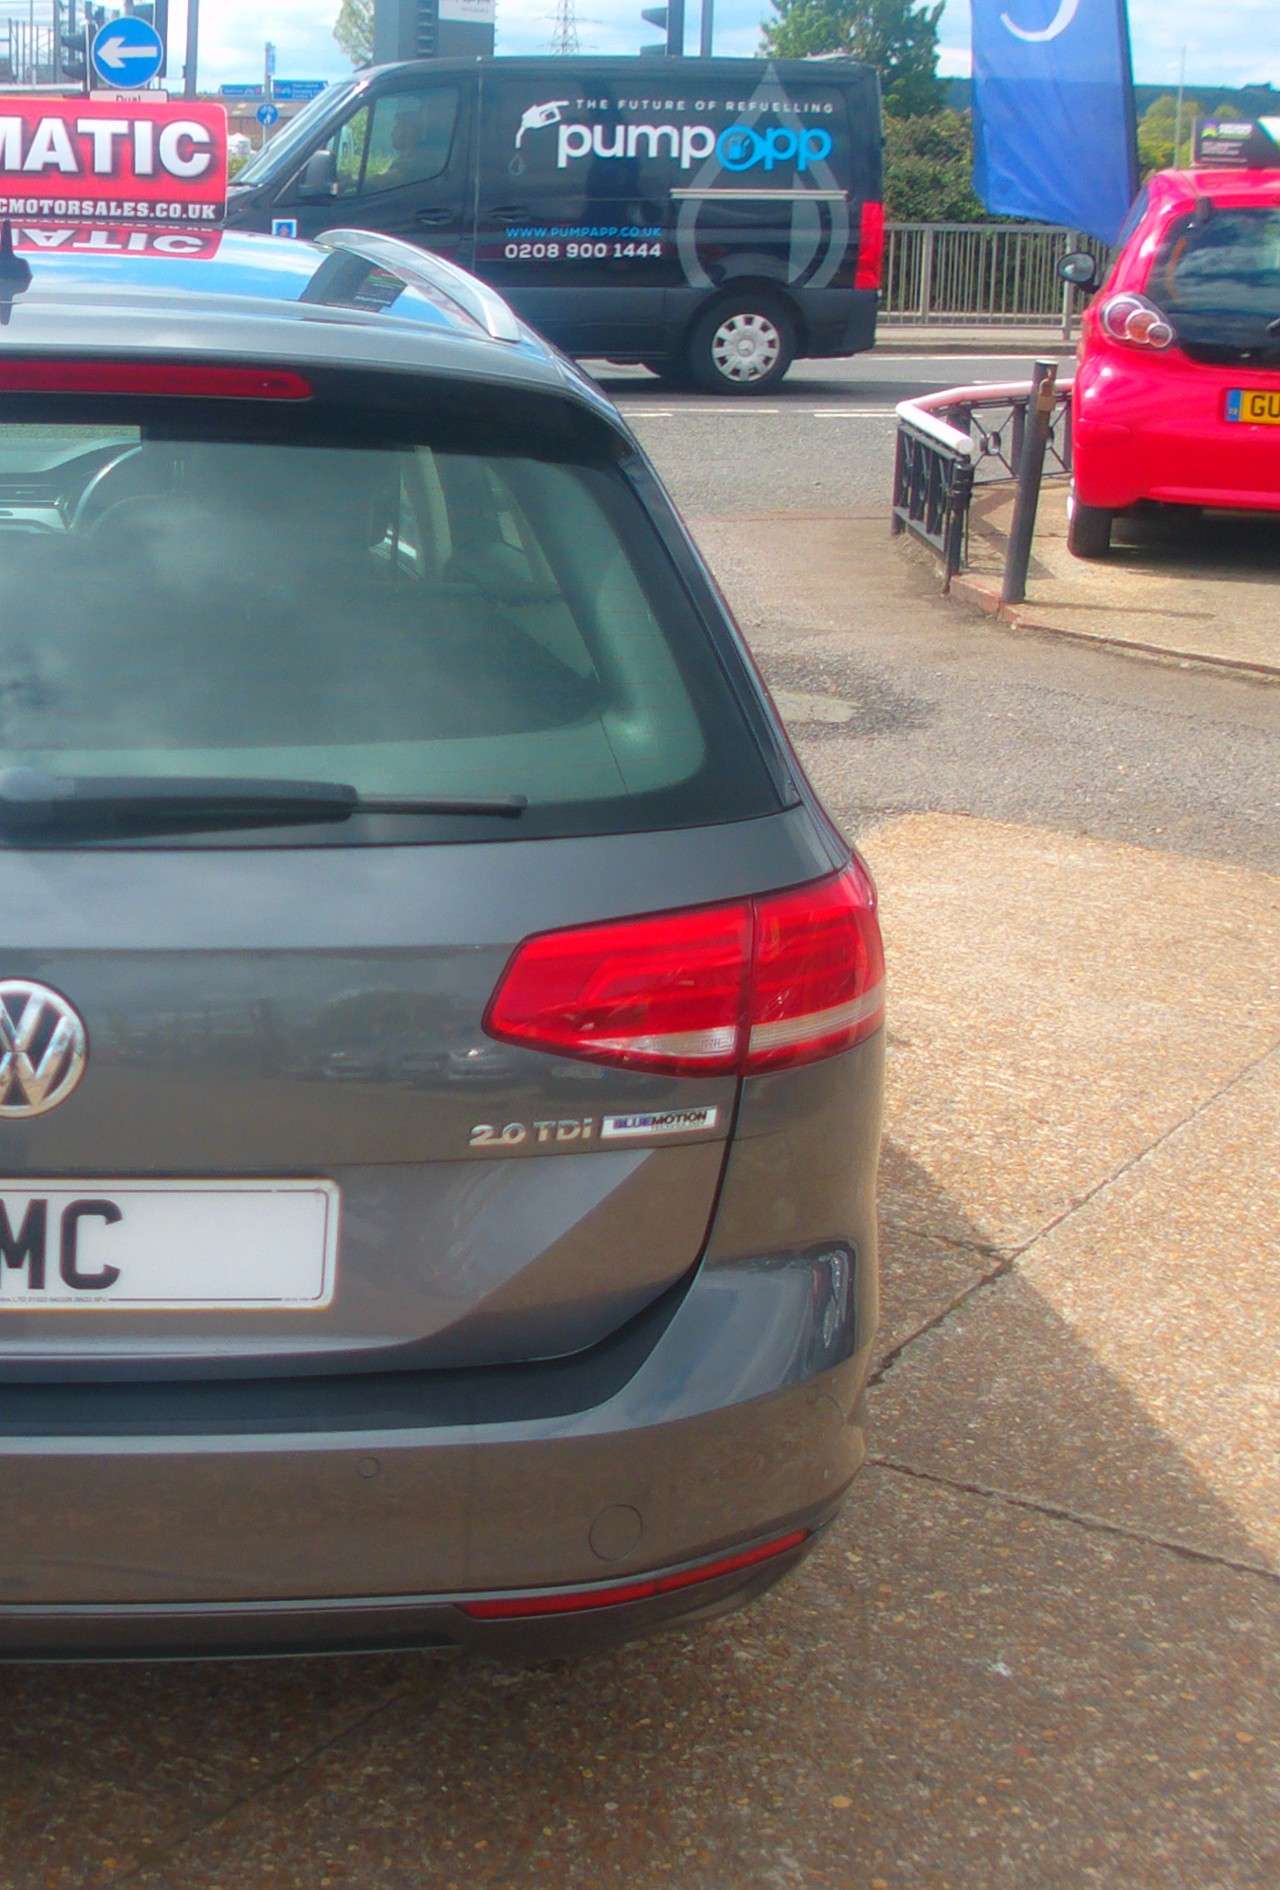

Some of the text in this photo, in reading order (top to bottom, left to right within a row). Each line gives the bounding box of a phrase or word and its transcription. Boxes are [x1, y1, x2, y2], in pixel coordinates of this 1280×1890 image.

[575, 99, 834, 114] THE FUTURE OF REFUELLING
[505, 226, 662, 238] WWW.PUMPAPP.CO.UK
[505, 243, 662, 258] 0208 900 1444
[469, 1122, 526, 1146] 2.0
[613, 1109, 708, 1129] BLUEMOTION
